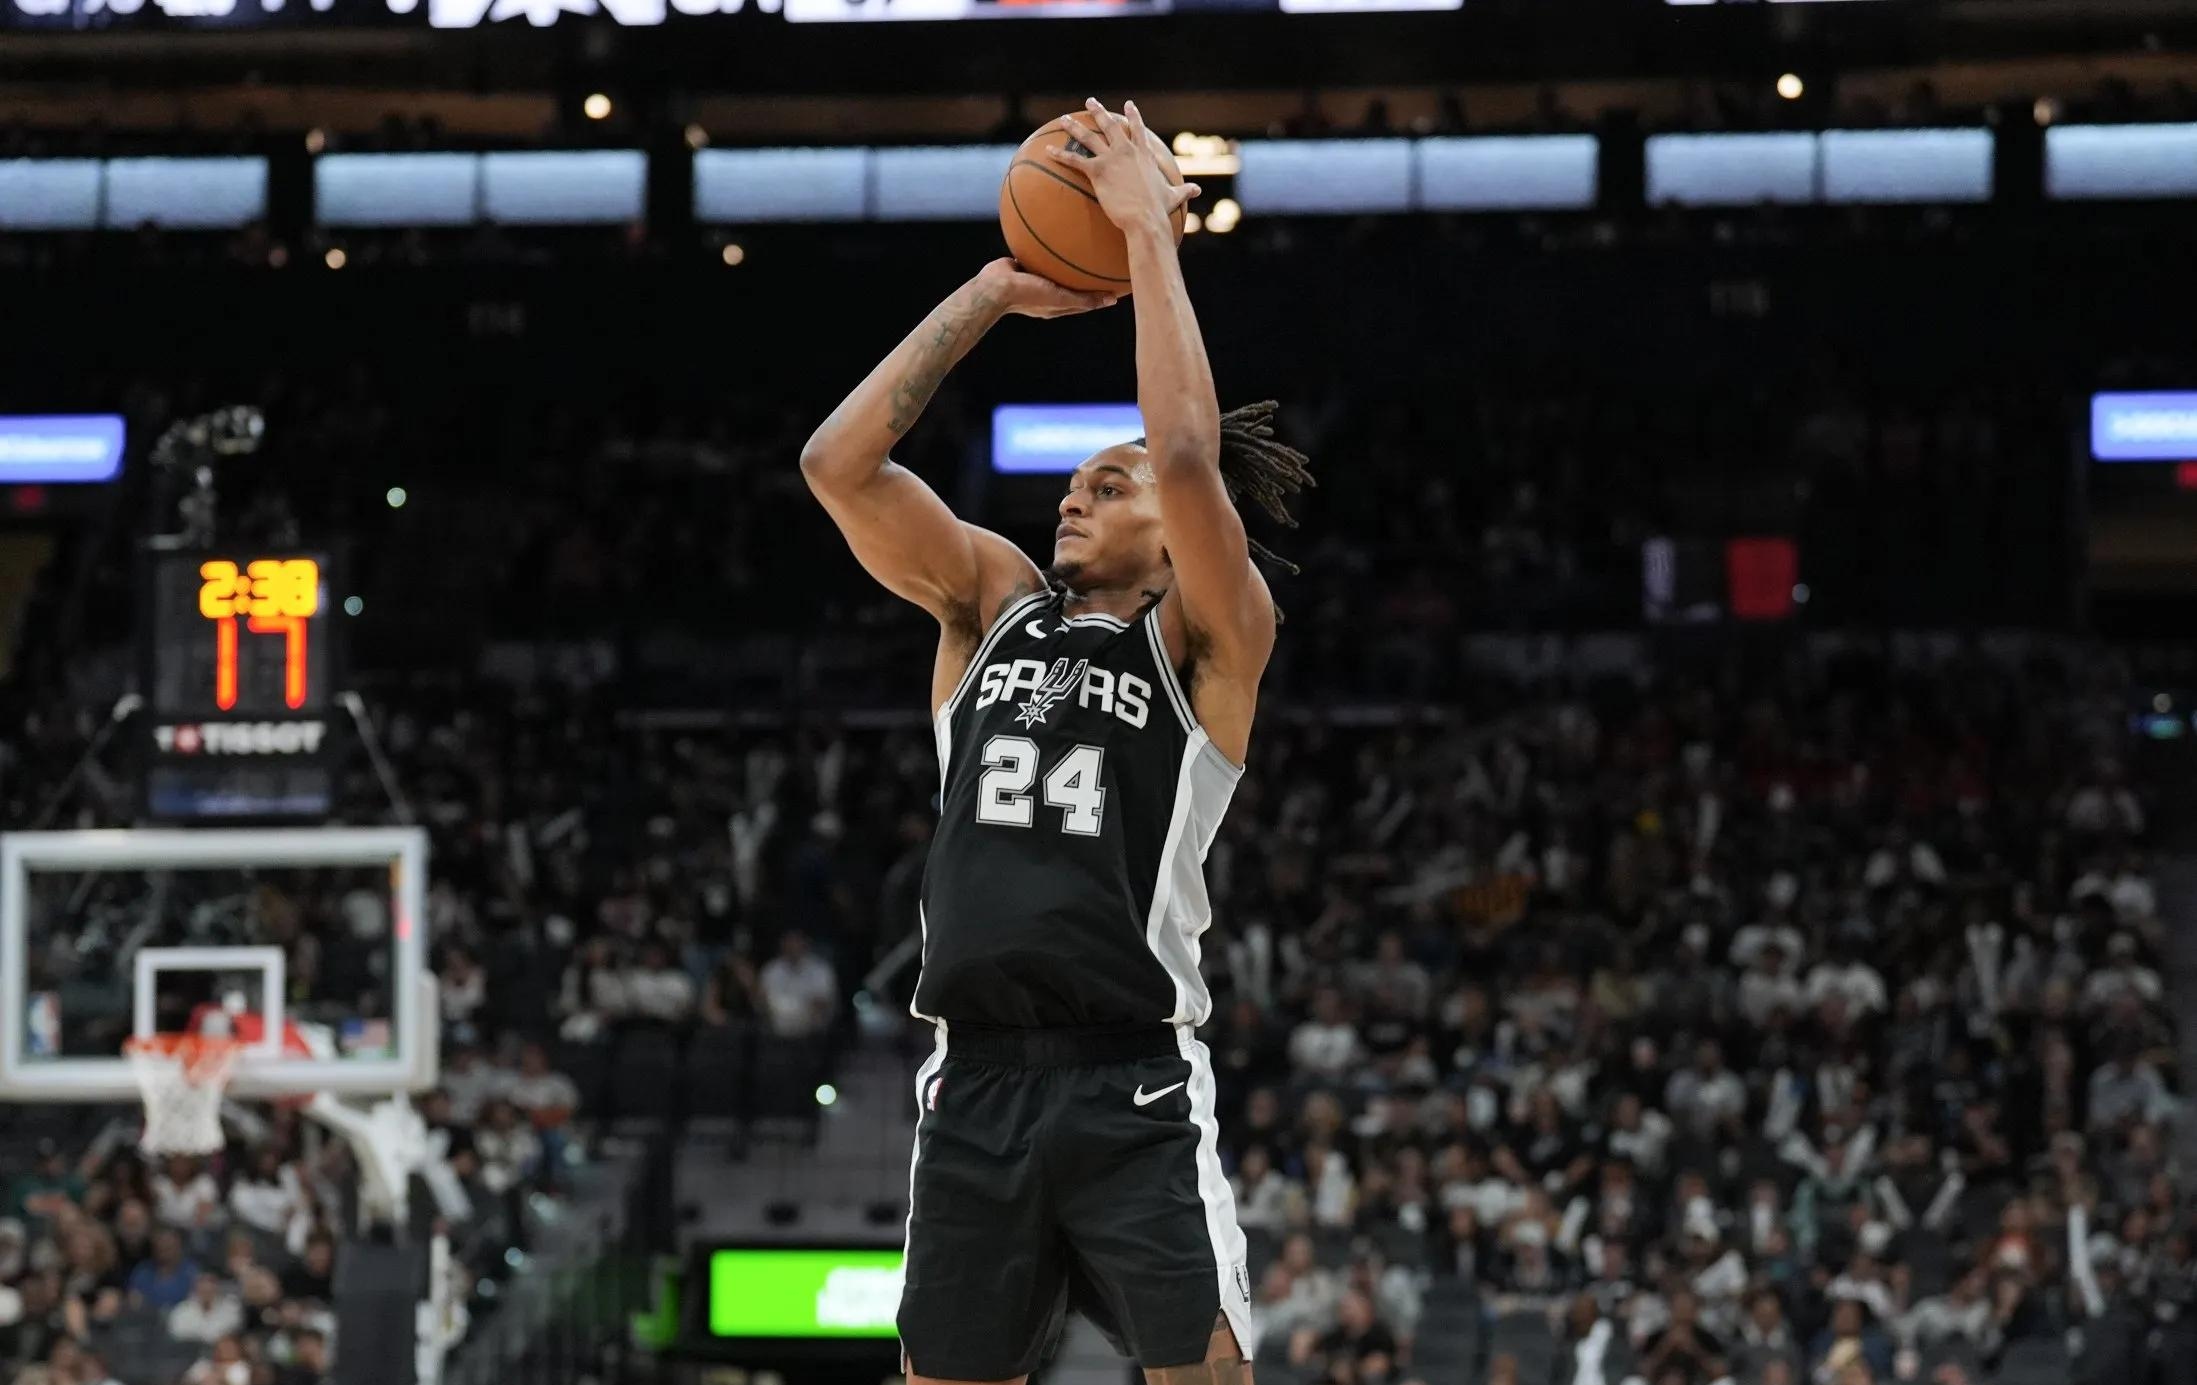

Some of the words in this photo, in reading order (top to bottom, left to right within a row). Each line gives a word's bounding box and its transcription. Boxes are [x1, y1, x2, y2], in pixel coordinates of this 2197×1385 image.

[200, 559, 318, 618] 2:38
[217, 617, 307, 711] 17
[975, 657, 1152, 730] SPURS
[976, 734, 1106, 837] 24
